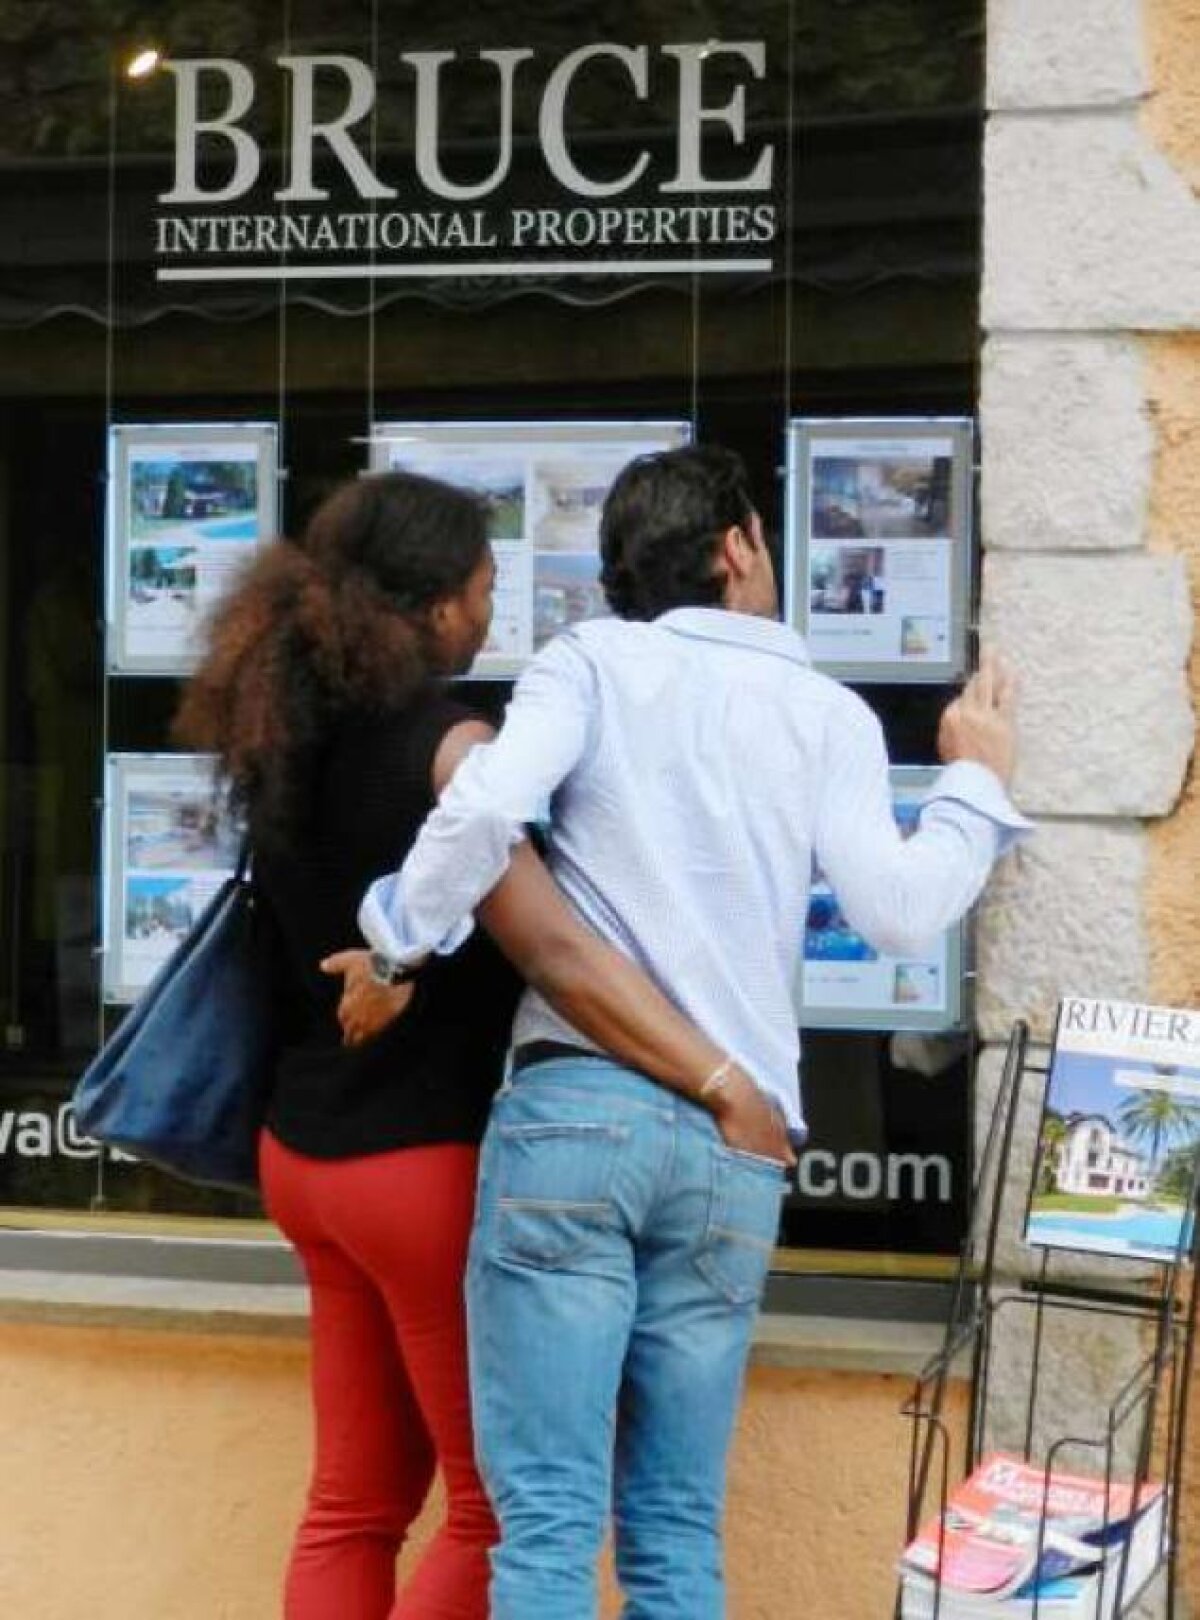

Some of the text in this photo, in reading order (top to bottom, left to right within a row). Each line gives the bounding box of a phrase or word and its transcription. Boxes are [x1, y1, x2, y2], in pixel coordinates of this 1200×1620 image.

[158, 40, 775, 205] BRUCE
[155, 205, 776, 254] INTERNATIONAL PROPERTIES
[1063, 999, 1200, 1042] RIVIER
